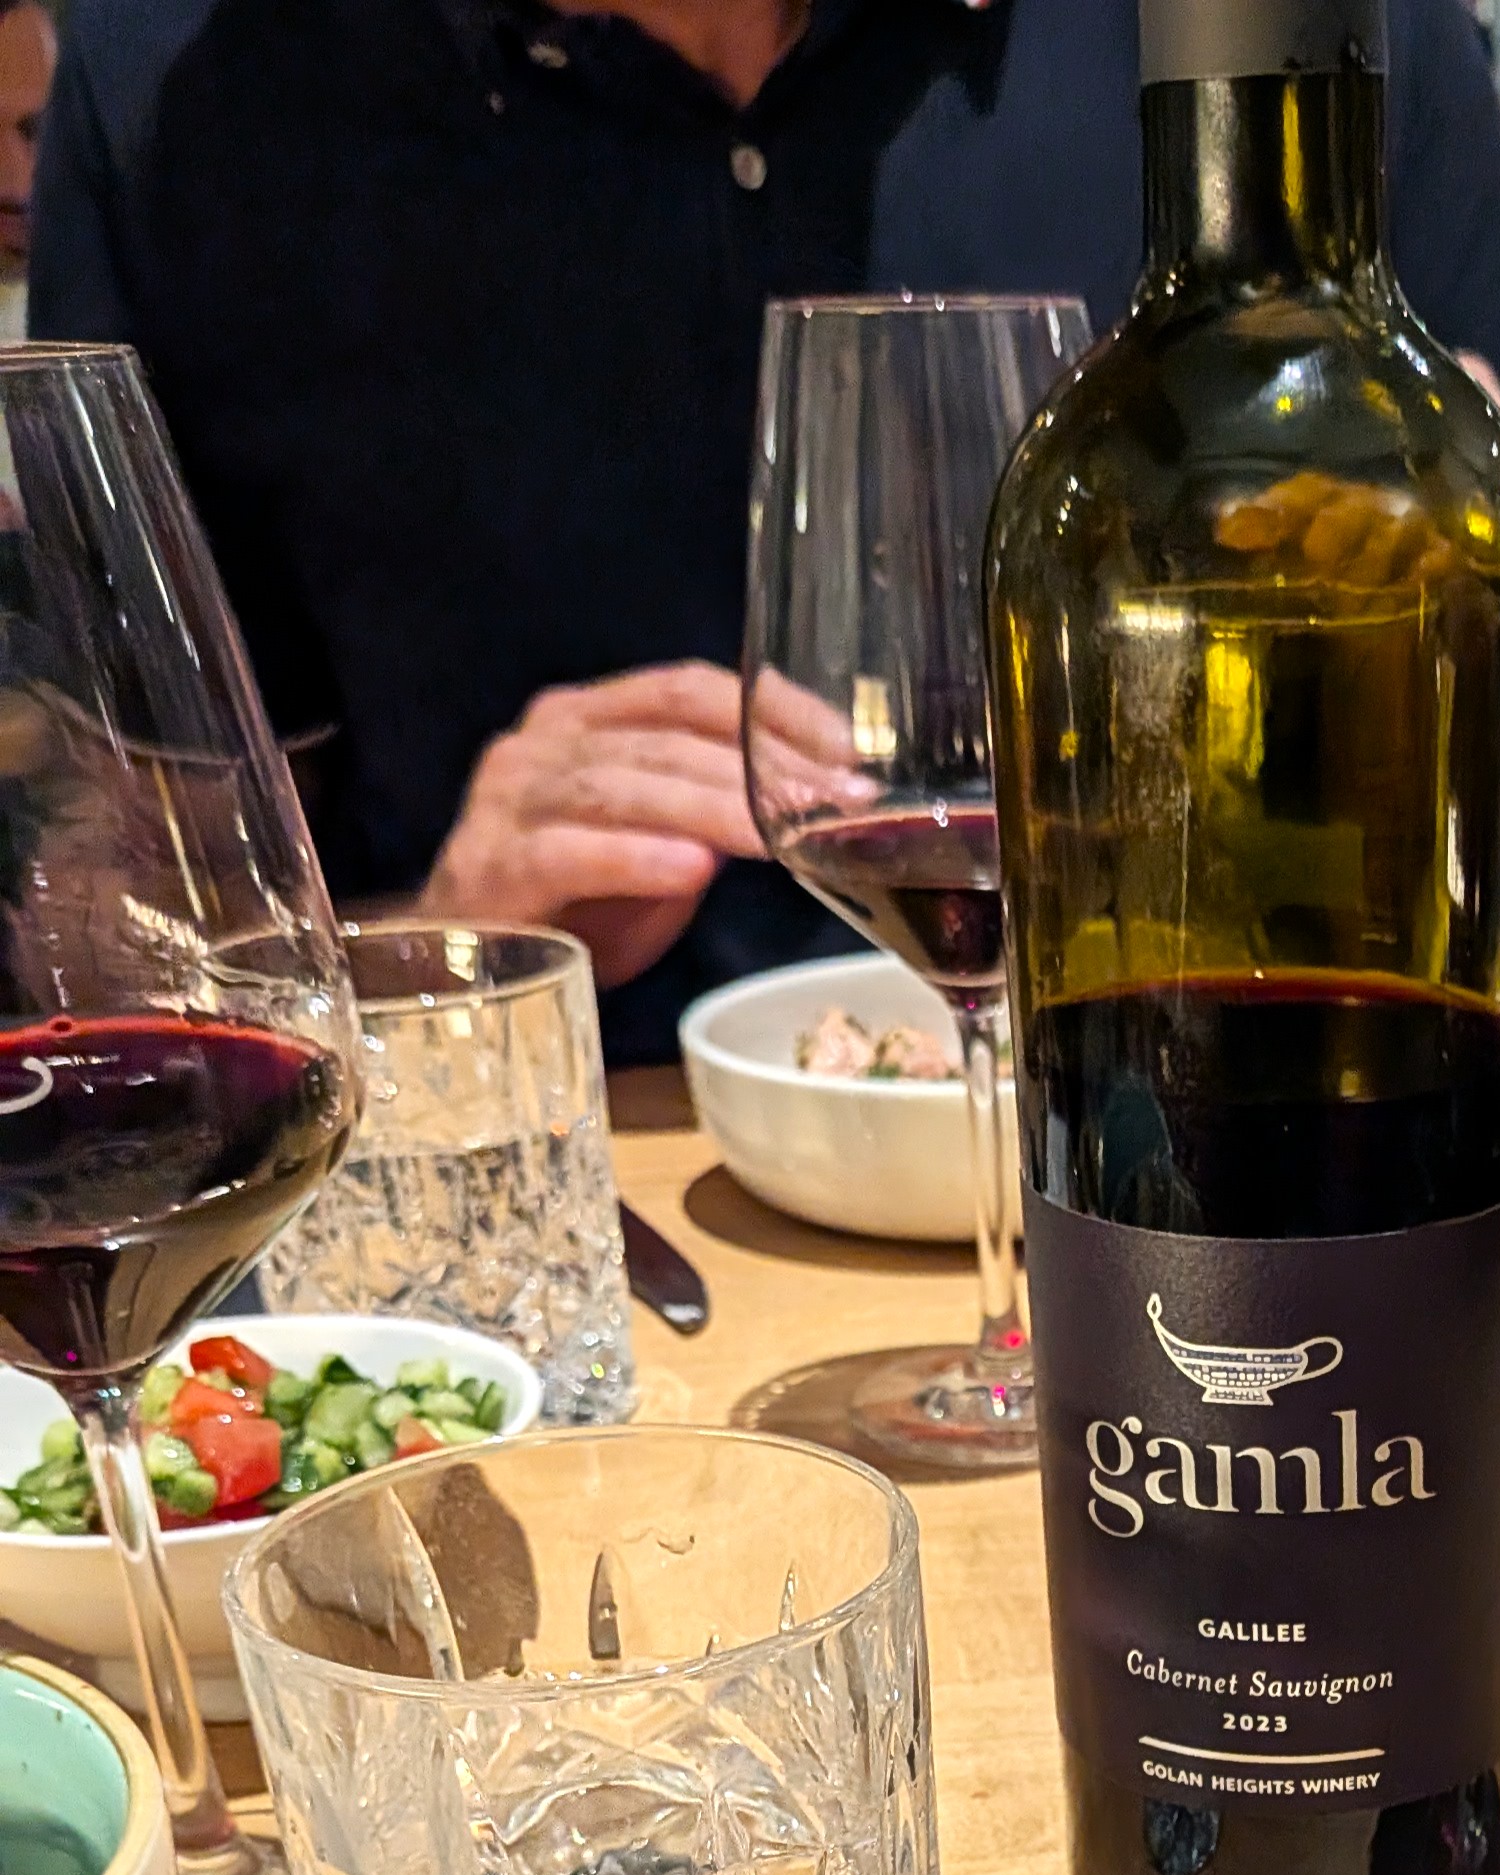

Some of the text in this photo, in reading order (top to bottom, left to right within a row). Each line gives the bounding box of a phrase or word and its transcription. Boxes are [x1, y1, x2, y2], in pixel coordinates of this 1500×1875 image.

[1086, 1409, 1436, 1538] gamla
[1198, 1618, 1307, 1643] GALILEE
[1126, 1649, 1394, 1705] Cabernet Sauvignon
[1223, 1712, 1289, 1734] 2023
[1142, 1759, 1382, 1796] GOLAN HEIGHTS WINERY
